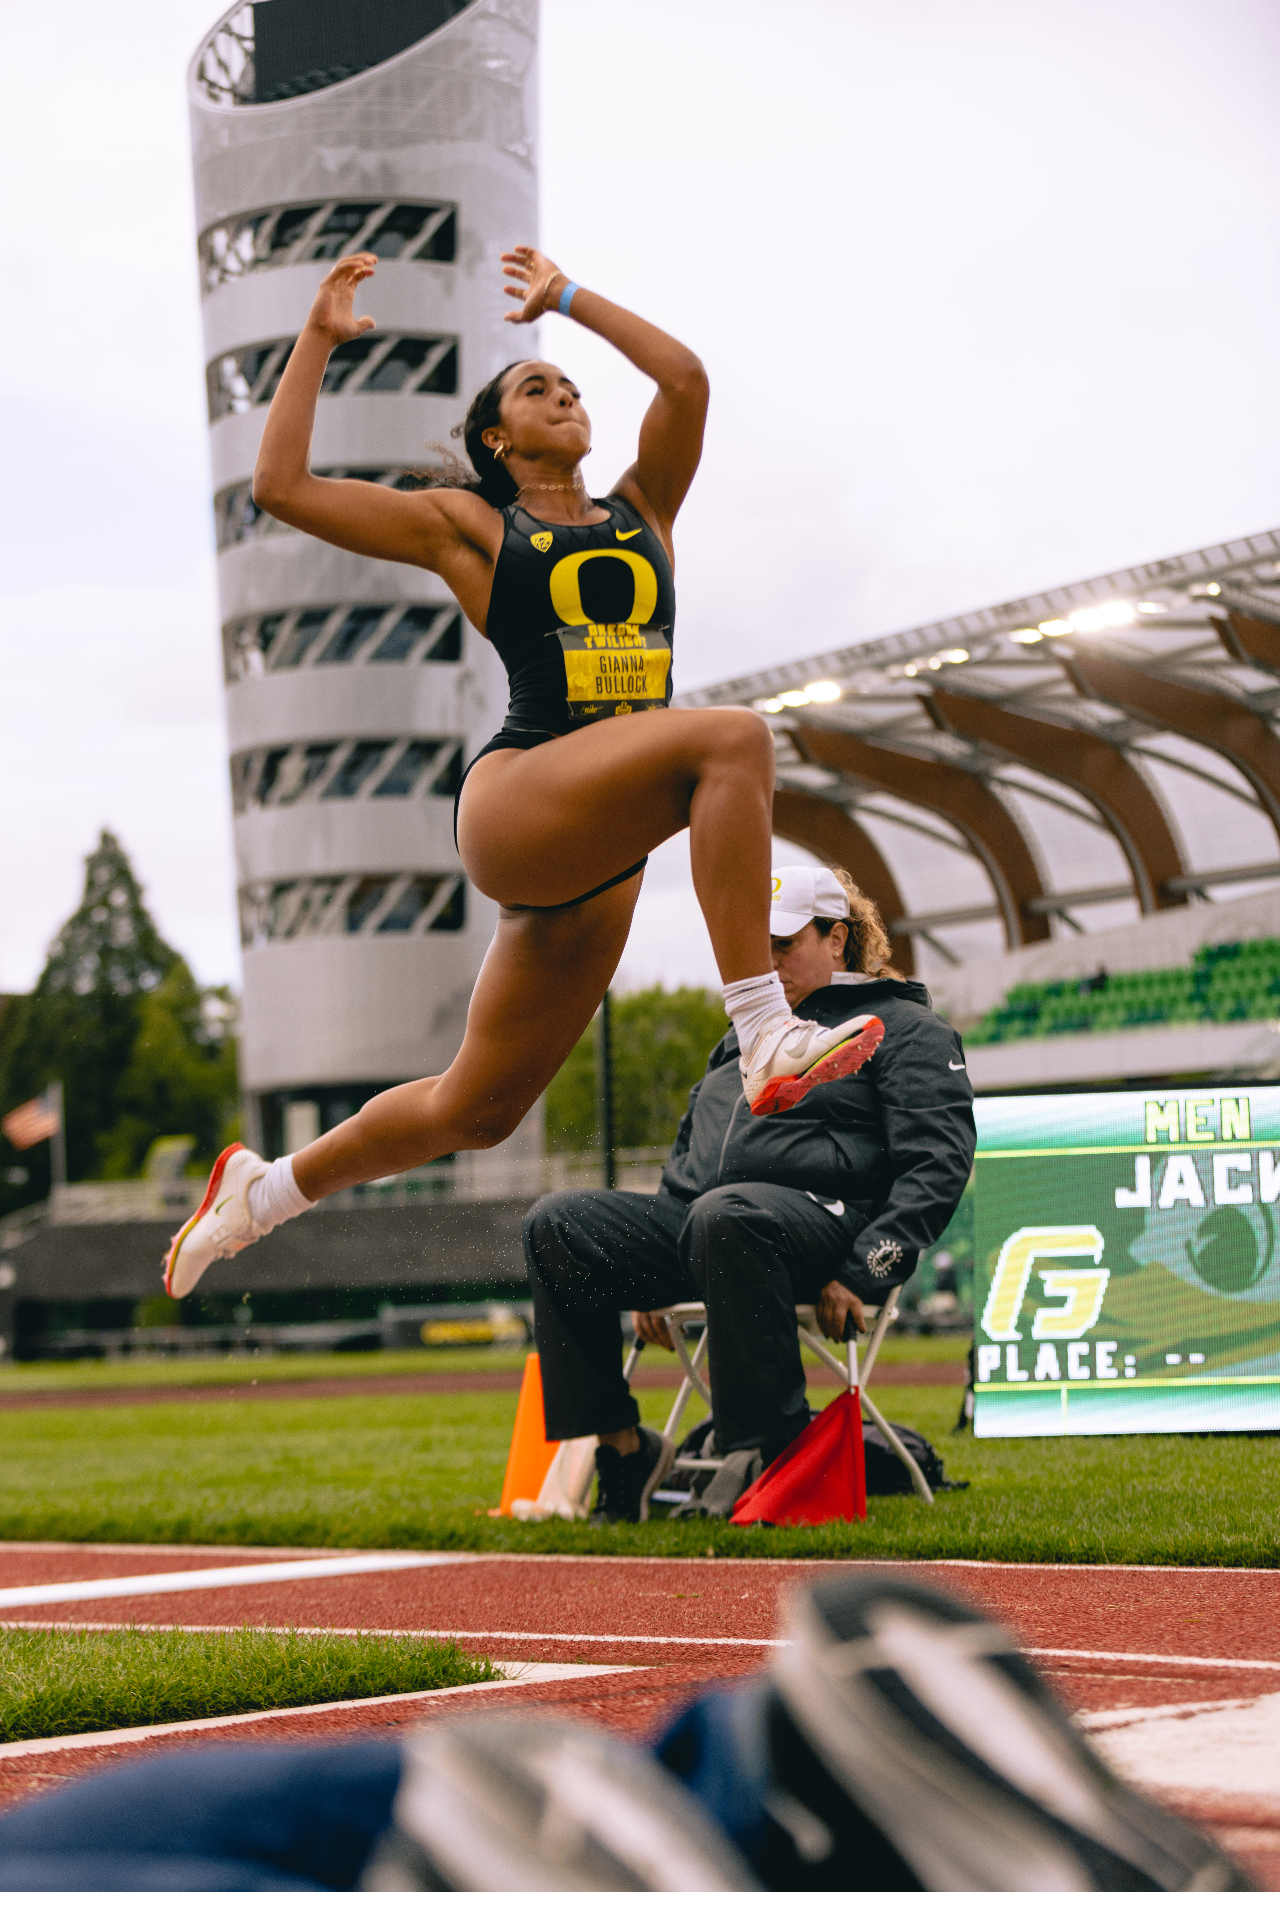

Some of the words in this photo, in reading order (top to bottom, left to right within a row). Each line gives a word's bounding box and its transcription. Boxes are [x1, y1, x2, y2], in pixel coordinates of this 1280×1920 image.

[549, 548, 658, 626] O
[595, 675, 648, 694] BULLOCK
[599, 655, 644, 673] GIANNA
[1144, 1096, 1251, 1143] MEN
[980, 1224, 1111, 1342] G
[977, 1340, 1137, 1382] PLACE:
